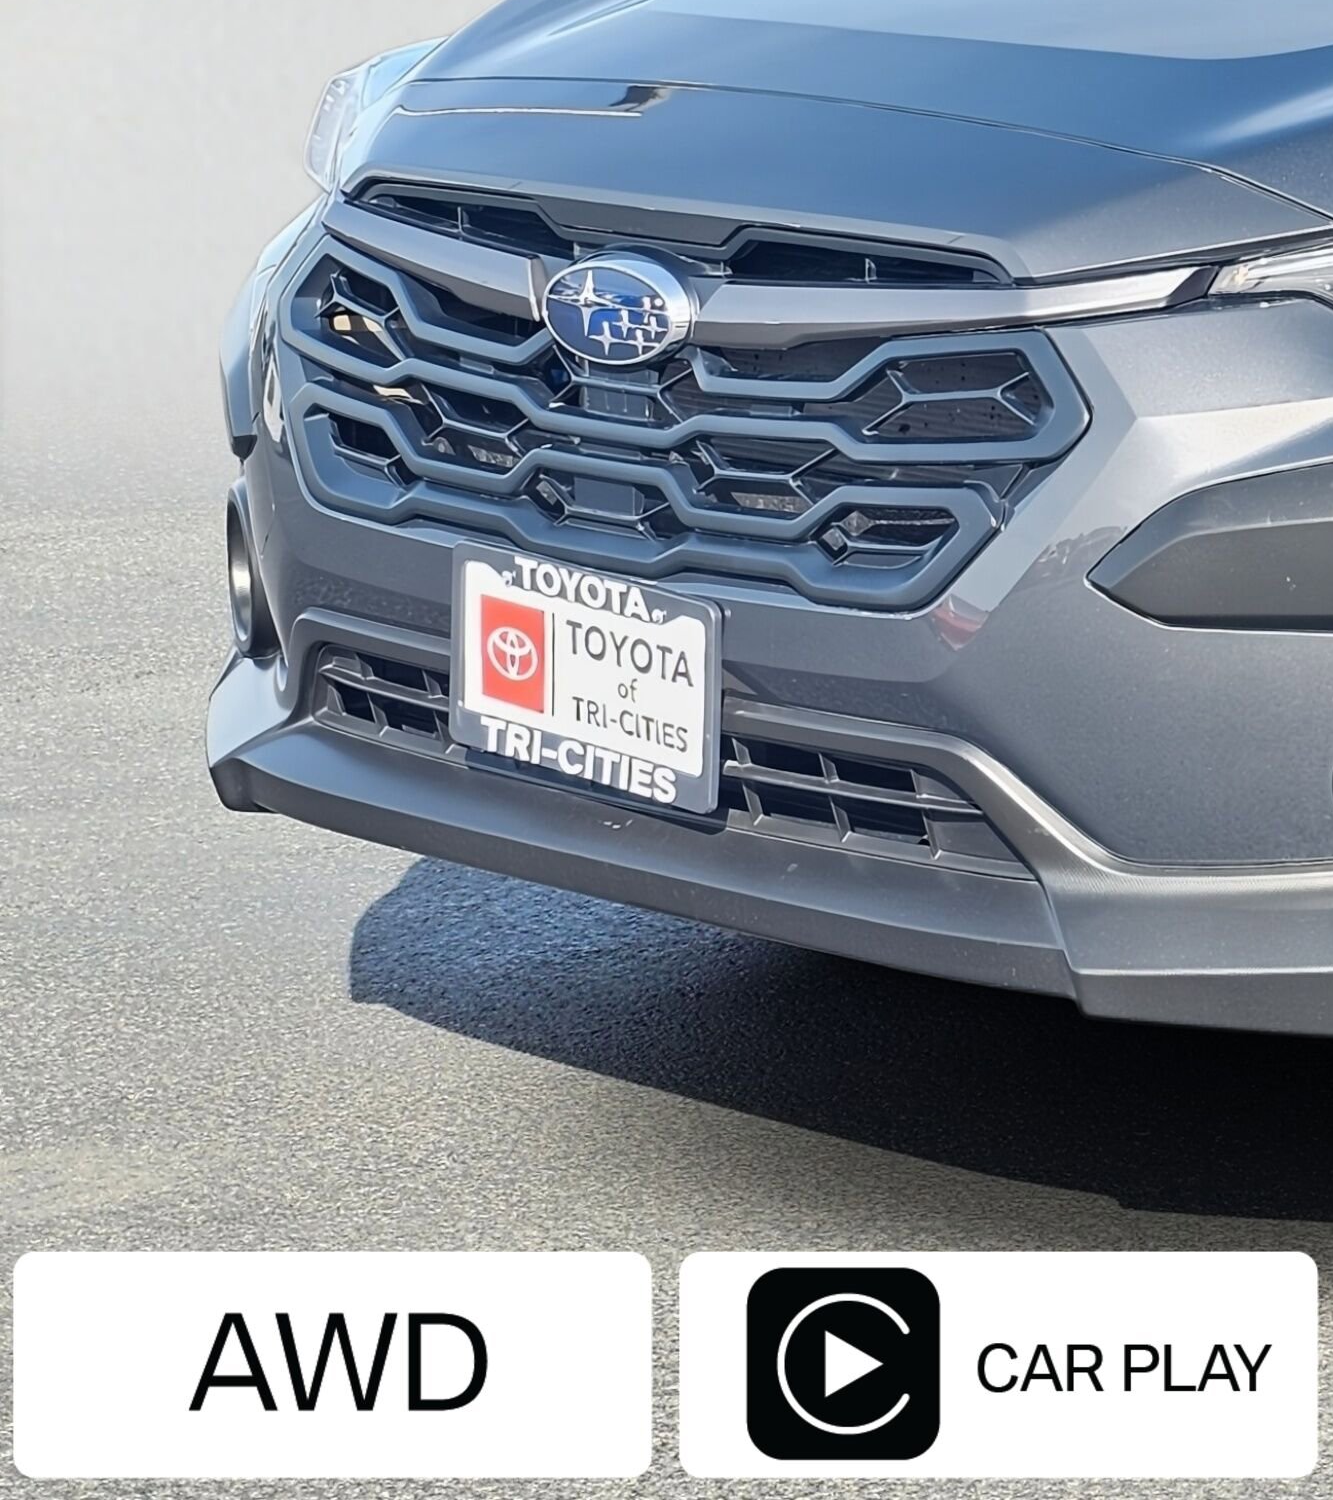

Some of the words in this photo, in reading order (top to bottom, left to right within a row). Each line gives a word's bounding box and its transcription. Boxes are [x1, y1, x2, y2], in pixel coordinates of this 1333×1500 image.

[514, 556, 651, 622] TOYOTA
[565, 619, 694, 688] TOYOTA
[617, 678, 638, 703] of
[571, 696, 688, 752] TRI-CITIES
[480, 715, 677, 804] TRI-CITIES
